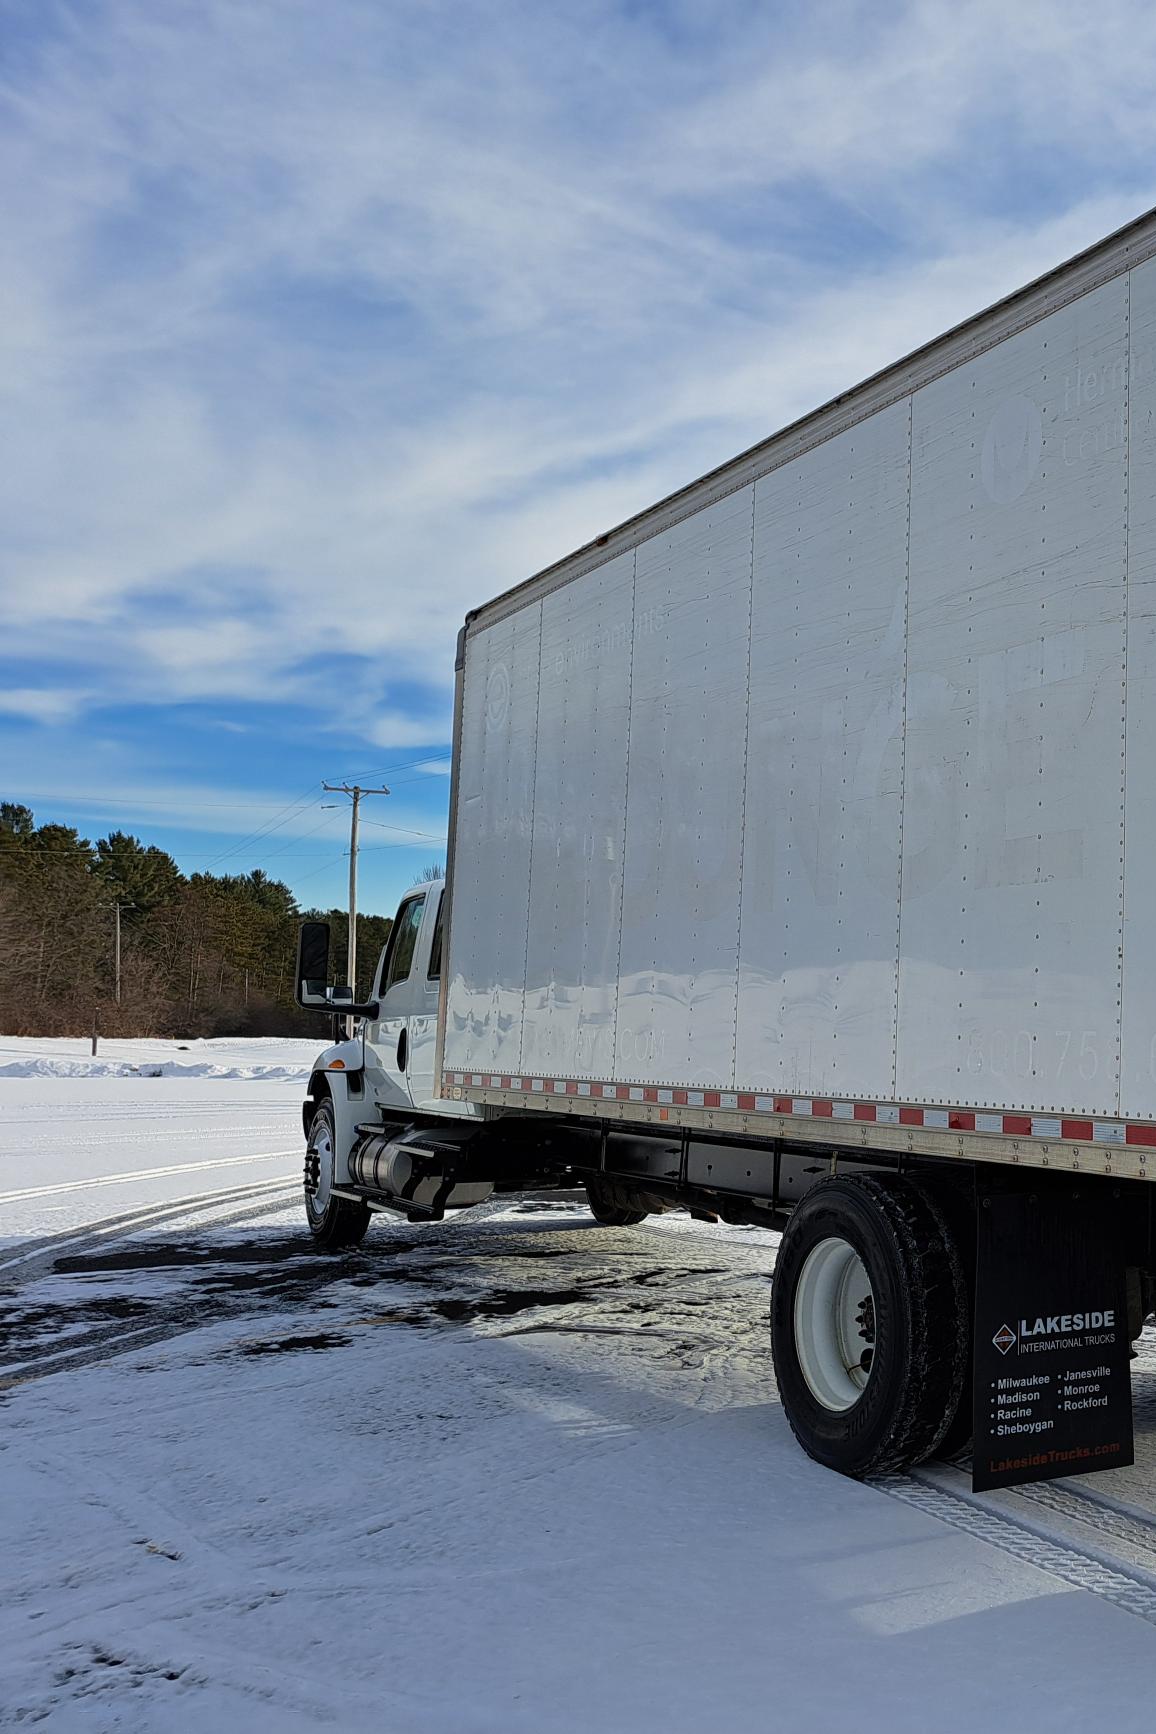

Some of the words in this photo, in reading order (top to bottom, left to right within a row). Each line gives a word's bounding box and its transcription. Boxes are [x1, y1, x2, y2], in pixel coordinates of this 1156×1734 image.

[1021, 1310, 1115, 1336] LAKESIDE
[1020, 1339, 1083, 1353] INTERNATIONAL
[1085, 1334, 1115, 1346] TRUCKS
[1064, 1367, 1111, 1381] Janesville
[998, 1375, 1050, 1389] Milwaukee
[1064, 1383, 1100, 1396] Monroe
[998, 1392, 1040, 1405] Madison
[1064, 1396, 1108, 1411] Rockford
[998, 1408, 1032, 1420] Racine
[997, 1420, 1054, 1435] Sheboygan
[990, 1443, 1120, 1472] LakesideTrucks.com
